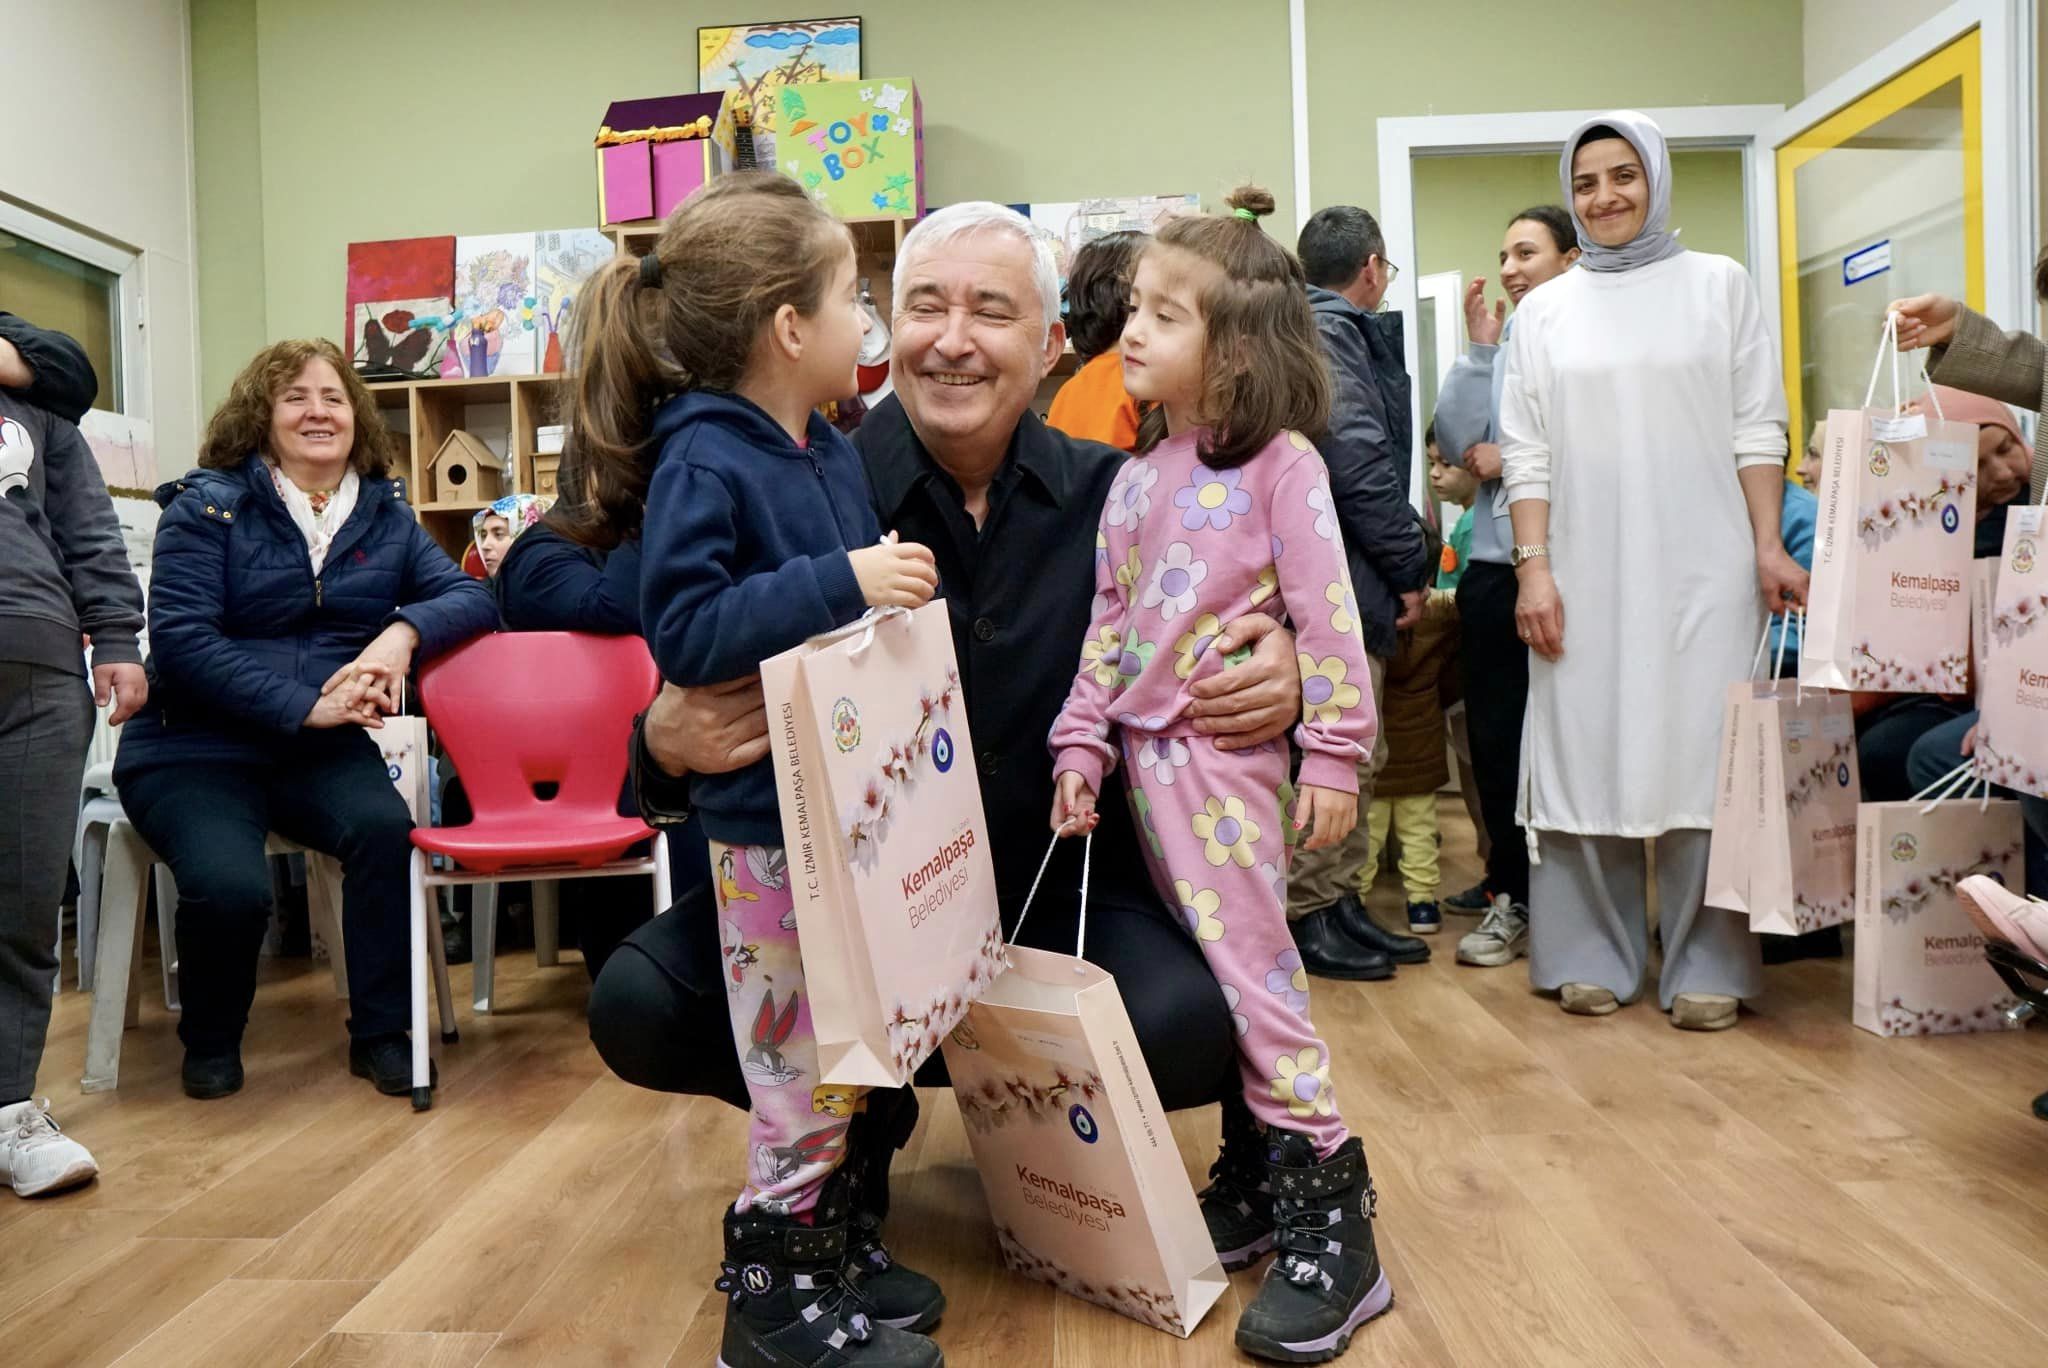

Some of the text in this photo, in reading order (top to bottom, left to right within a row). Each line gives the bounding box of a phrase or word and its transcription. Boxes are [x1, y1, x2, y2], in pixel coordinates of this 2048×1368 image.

[806, 112, 869, 153] TOY
[822, 136, 885, 181] BOX
[1891, 571, 1960, 597] Kemalpaşa
[782, 702, 820, 901] T.C. İZMİR KEMALPAŞA BELEDİYESİ
[901, 829, 975, 901] Kemalpaşa
[908, 862, 969, 929] Belediyesi
[1924, 933, 1984, 950] Kemalp
[1016, 1163, 1126, 1219] Kemalpaşa
[1022, 1186, 1110, 1233] Belediyesi
[748, 1270, 765, 1289] N
